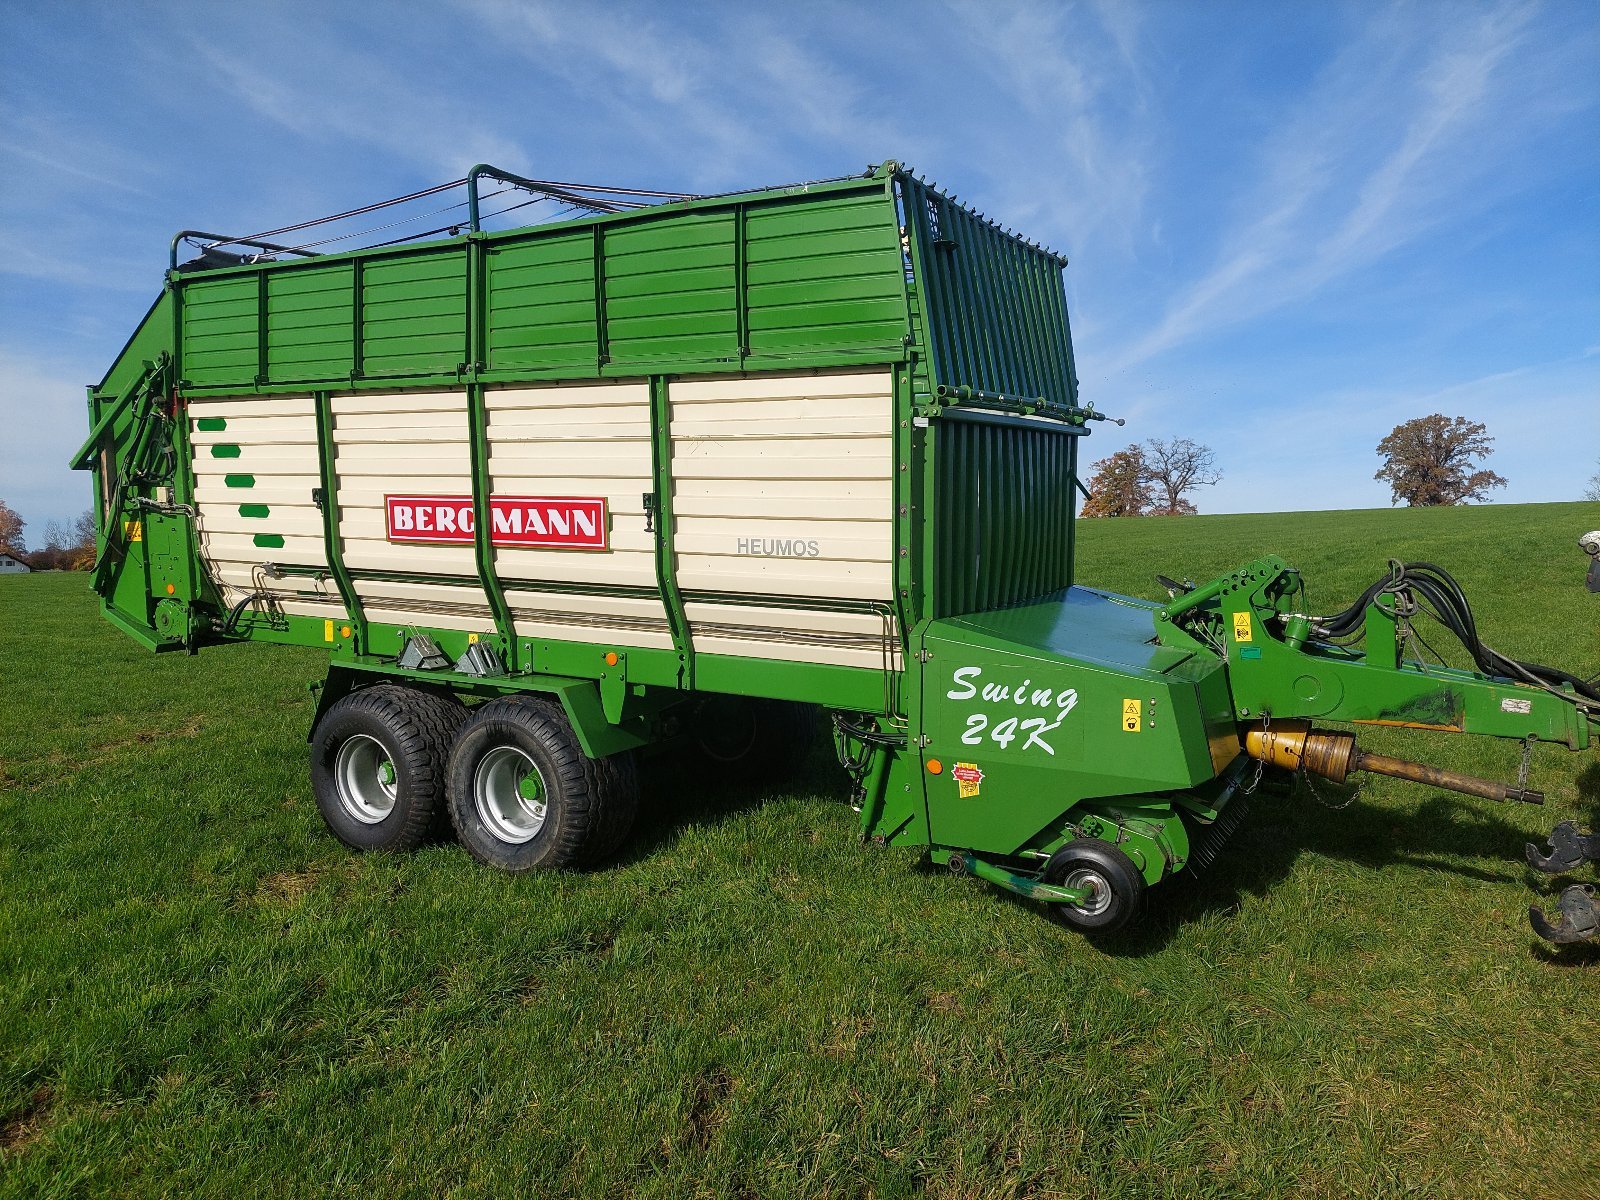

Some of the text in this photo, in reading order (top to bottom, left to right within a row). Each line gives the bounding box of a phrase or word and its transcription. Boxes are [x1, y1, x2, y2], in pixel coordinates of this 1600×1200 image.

[737, 538, 820, 557] HEUMOS
[946, 666, 1078, 721] Swing
[961, 713, 1061, 755] 24K
